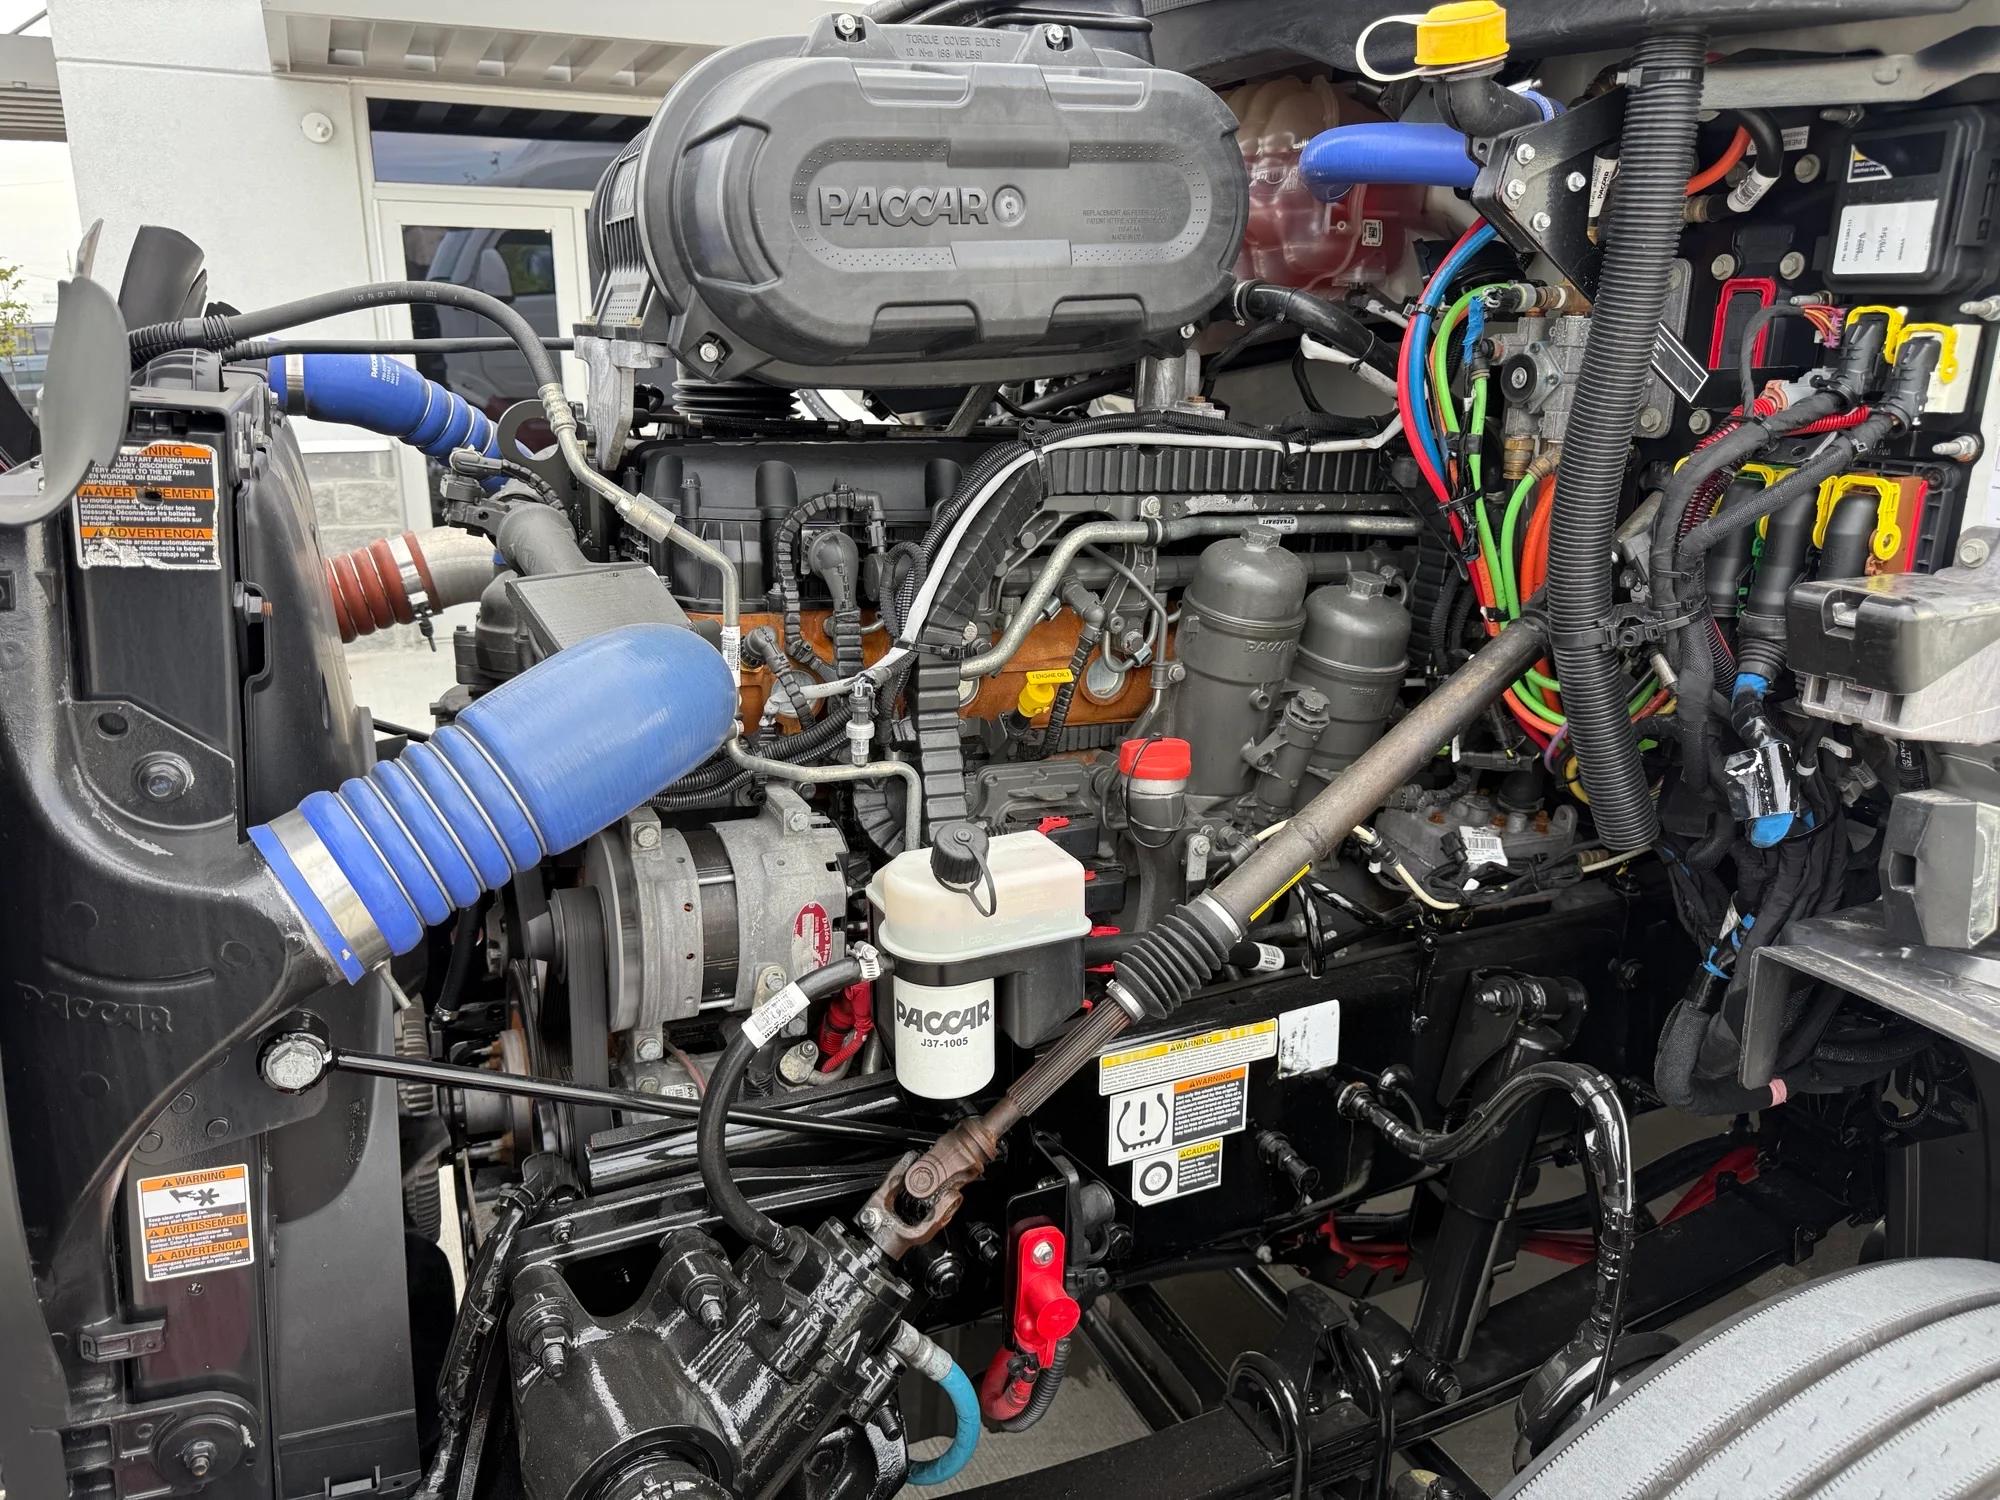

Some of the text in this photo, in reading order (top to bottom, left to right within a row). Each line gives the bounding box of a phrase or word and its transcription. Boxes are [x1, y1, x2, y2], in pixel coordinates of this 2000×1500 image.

[906, 34, 939, 44] TORQUE
[944, 36, 971, 46] COVER
[818, 186, 989, 227] PACCAR
[144, 446, 182, 456] NING
[94, 487, 208, 498] AVERTEMENT
[108, 528, 205, 538] ADVERTENCIA
[896, 998, 990, 1036] PACCAR
[920, 1037, 968, 1048] J37-1005
[1174, 1036, 1213, 1051] WARNING
[1194, 1071, 1232, 1087] WARNING
[1185, 1141, 1221, 1157] CAUTION
[175, 1170, 226, 1185] WARNING
[164, 1215, 245, 1235] AVERTISSEMENT
[171, 1241, 242, 1259] ADVERTENCIA
